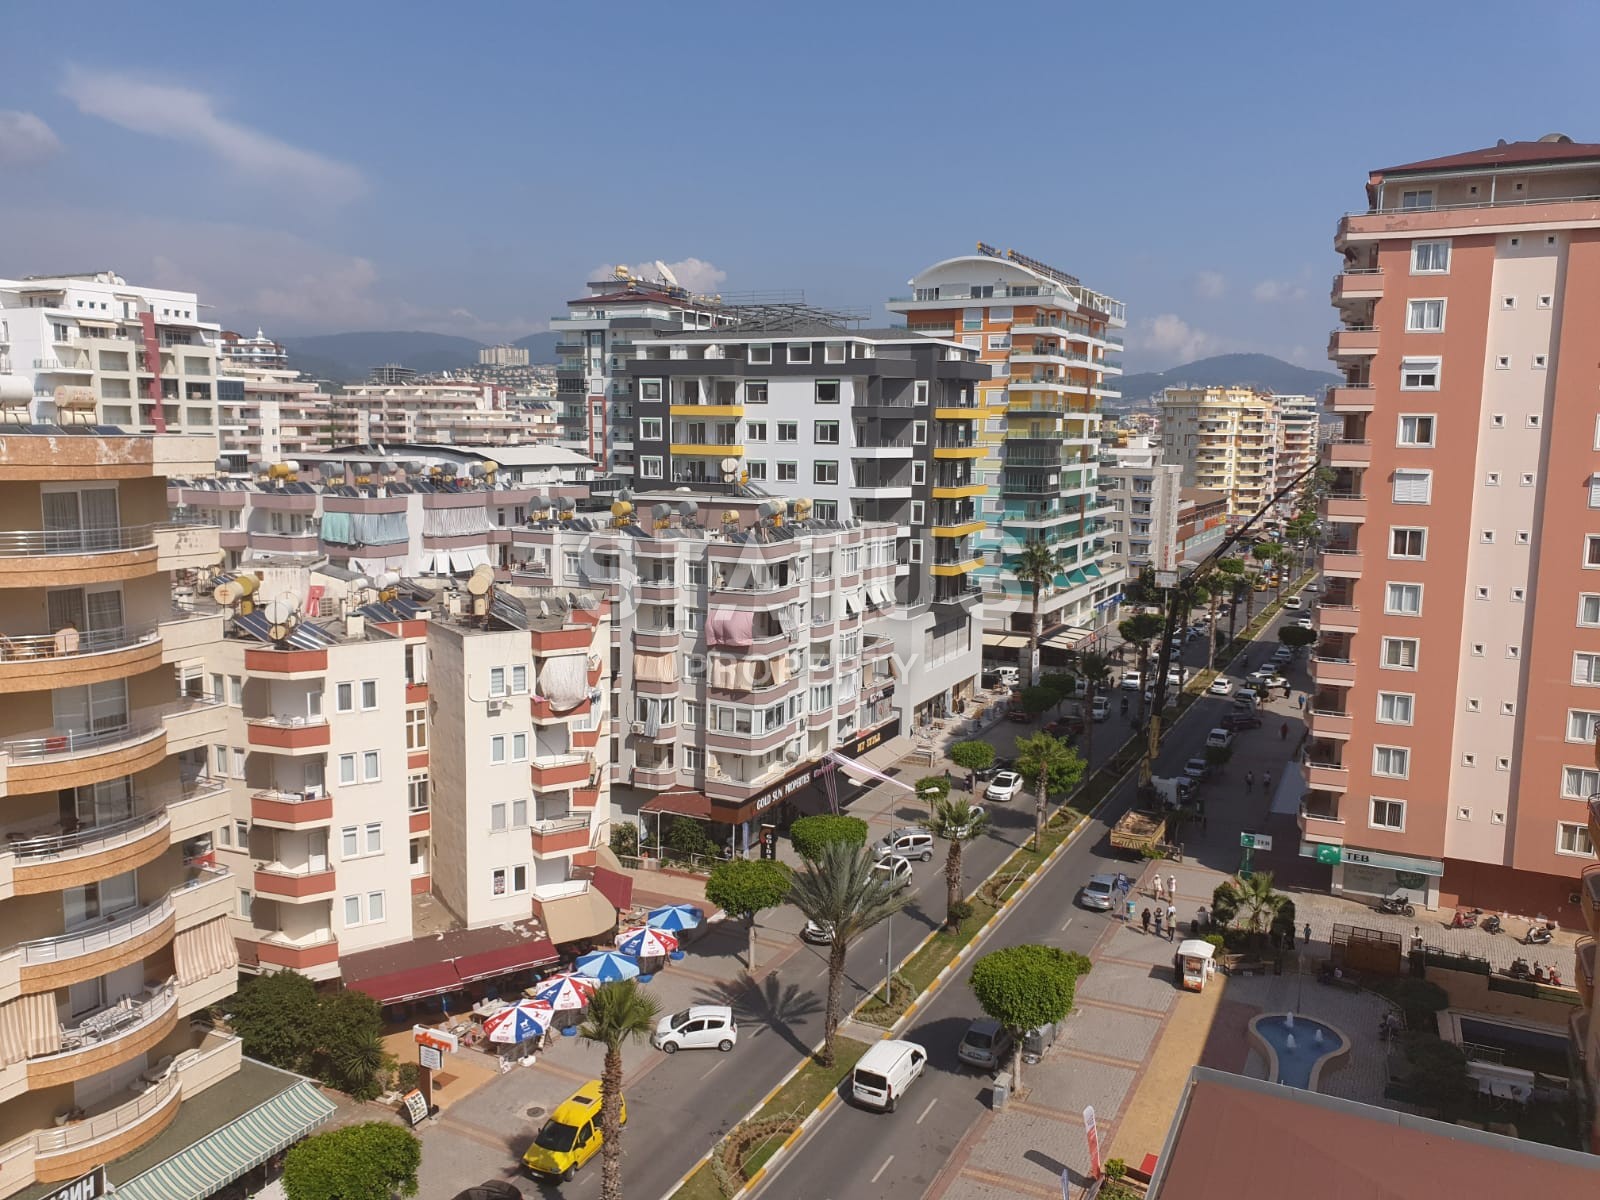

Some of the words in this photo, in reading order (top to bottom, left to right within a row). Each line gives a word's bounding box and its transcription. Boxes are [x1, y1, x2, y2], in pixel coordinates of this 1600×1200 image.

[756, 794, 772, 810] GOLD
[772, 788, 783, 802] SUN
[785, 772, 810, 795] PROPERTIES
[1346, 852, 1370, 863] TEB
